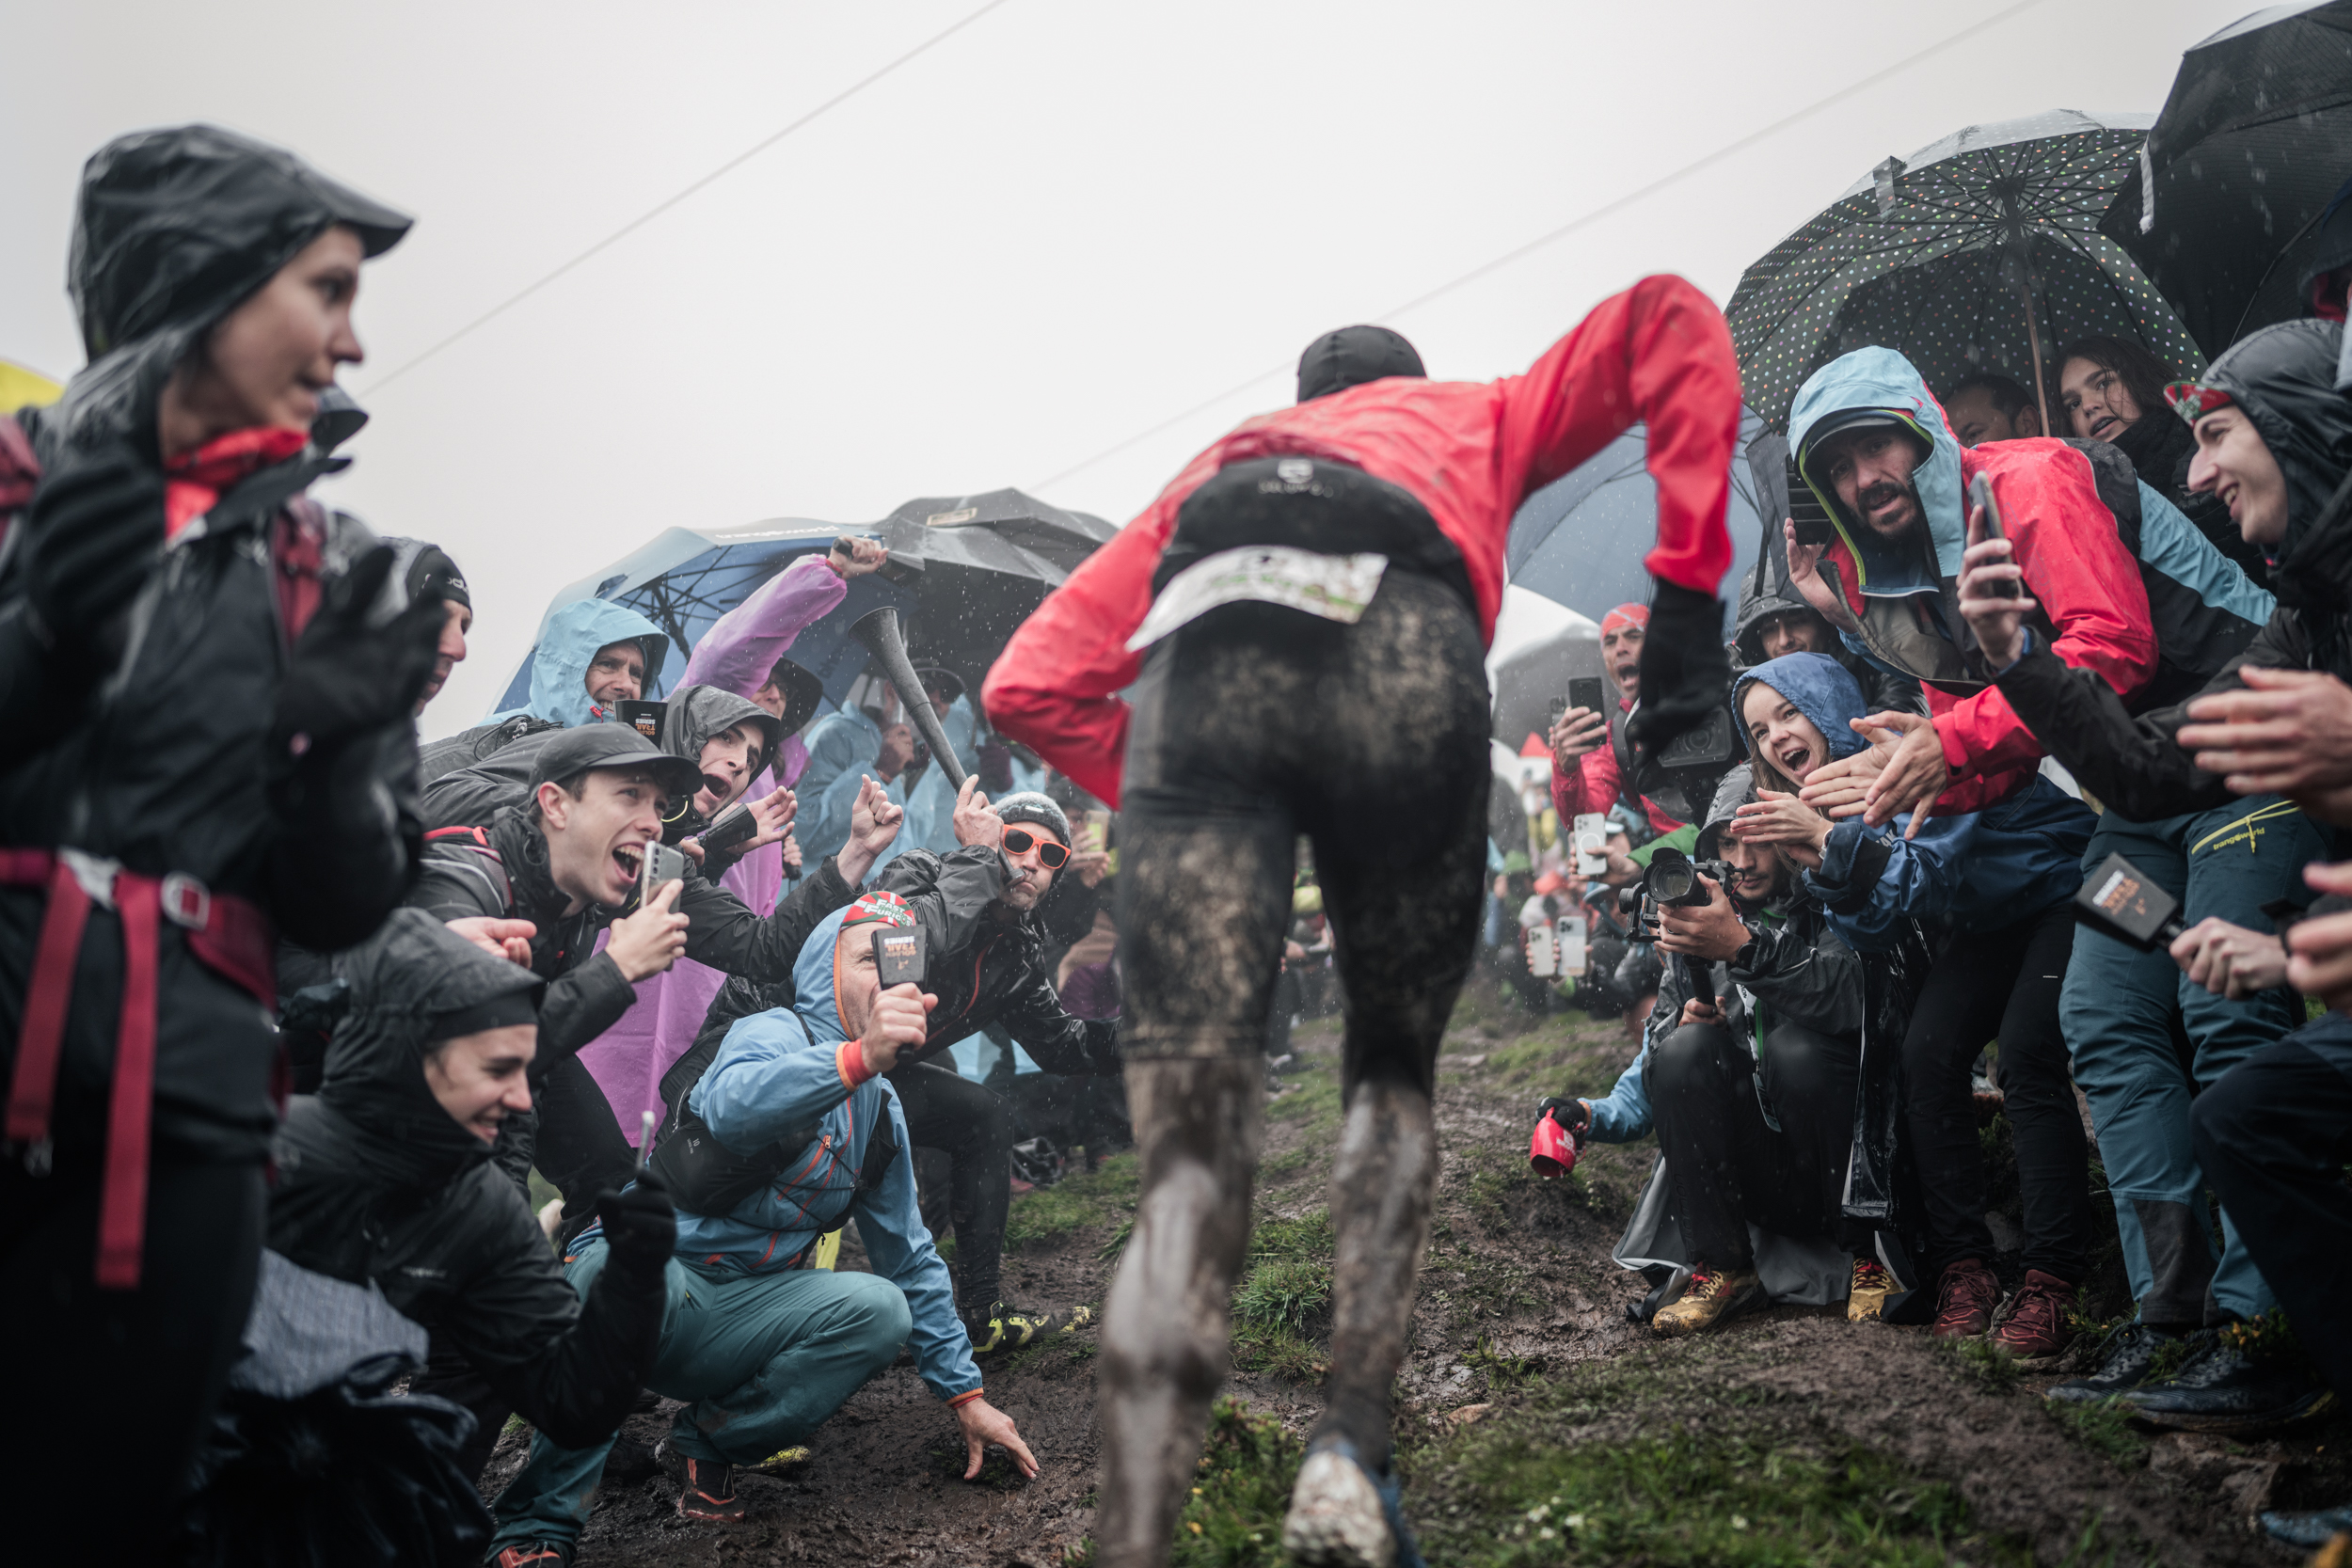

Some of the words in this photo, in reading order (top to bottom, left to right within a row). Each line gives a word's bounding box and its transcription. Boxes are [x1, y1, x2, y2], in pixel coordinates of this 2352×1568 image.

[1875, 829, 1898, 847] AK
[876, 898, 906, 913] FAST
[863, 903, 913, 927] FURIOUS
[884, 935, 915, 944] SERIES
[884, 942, 916, 952] TRAIL
[692, 1138, 700, 1147] 10
